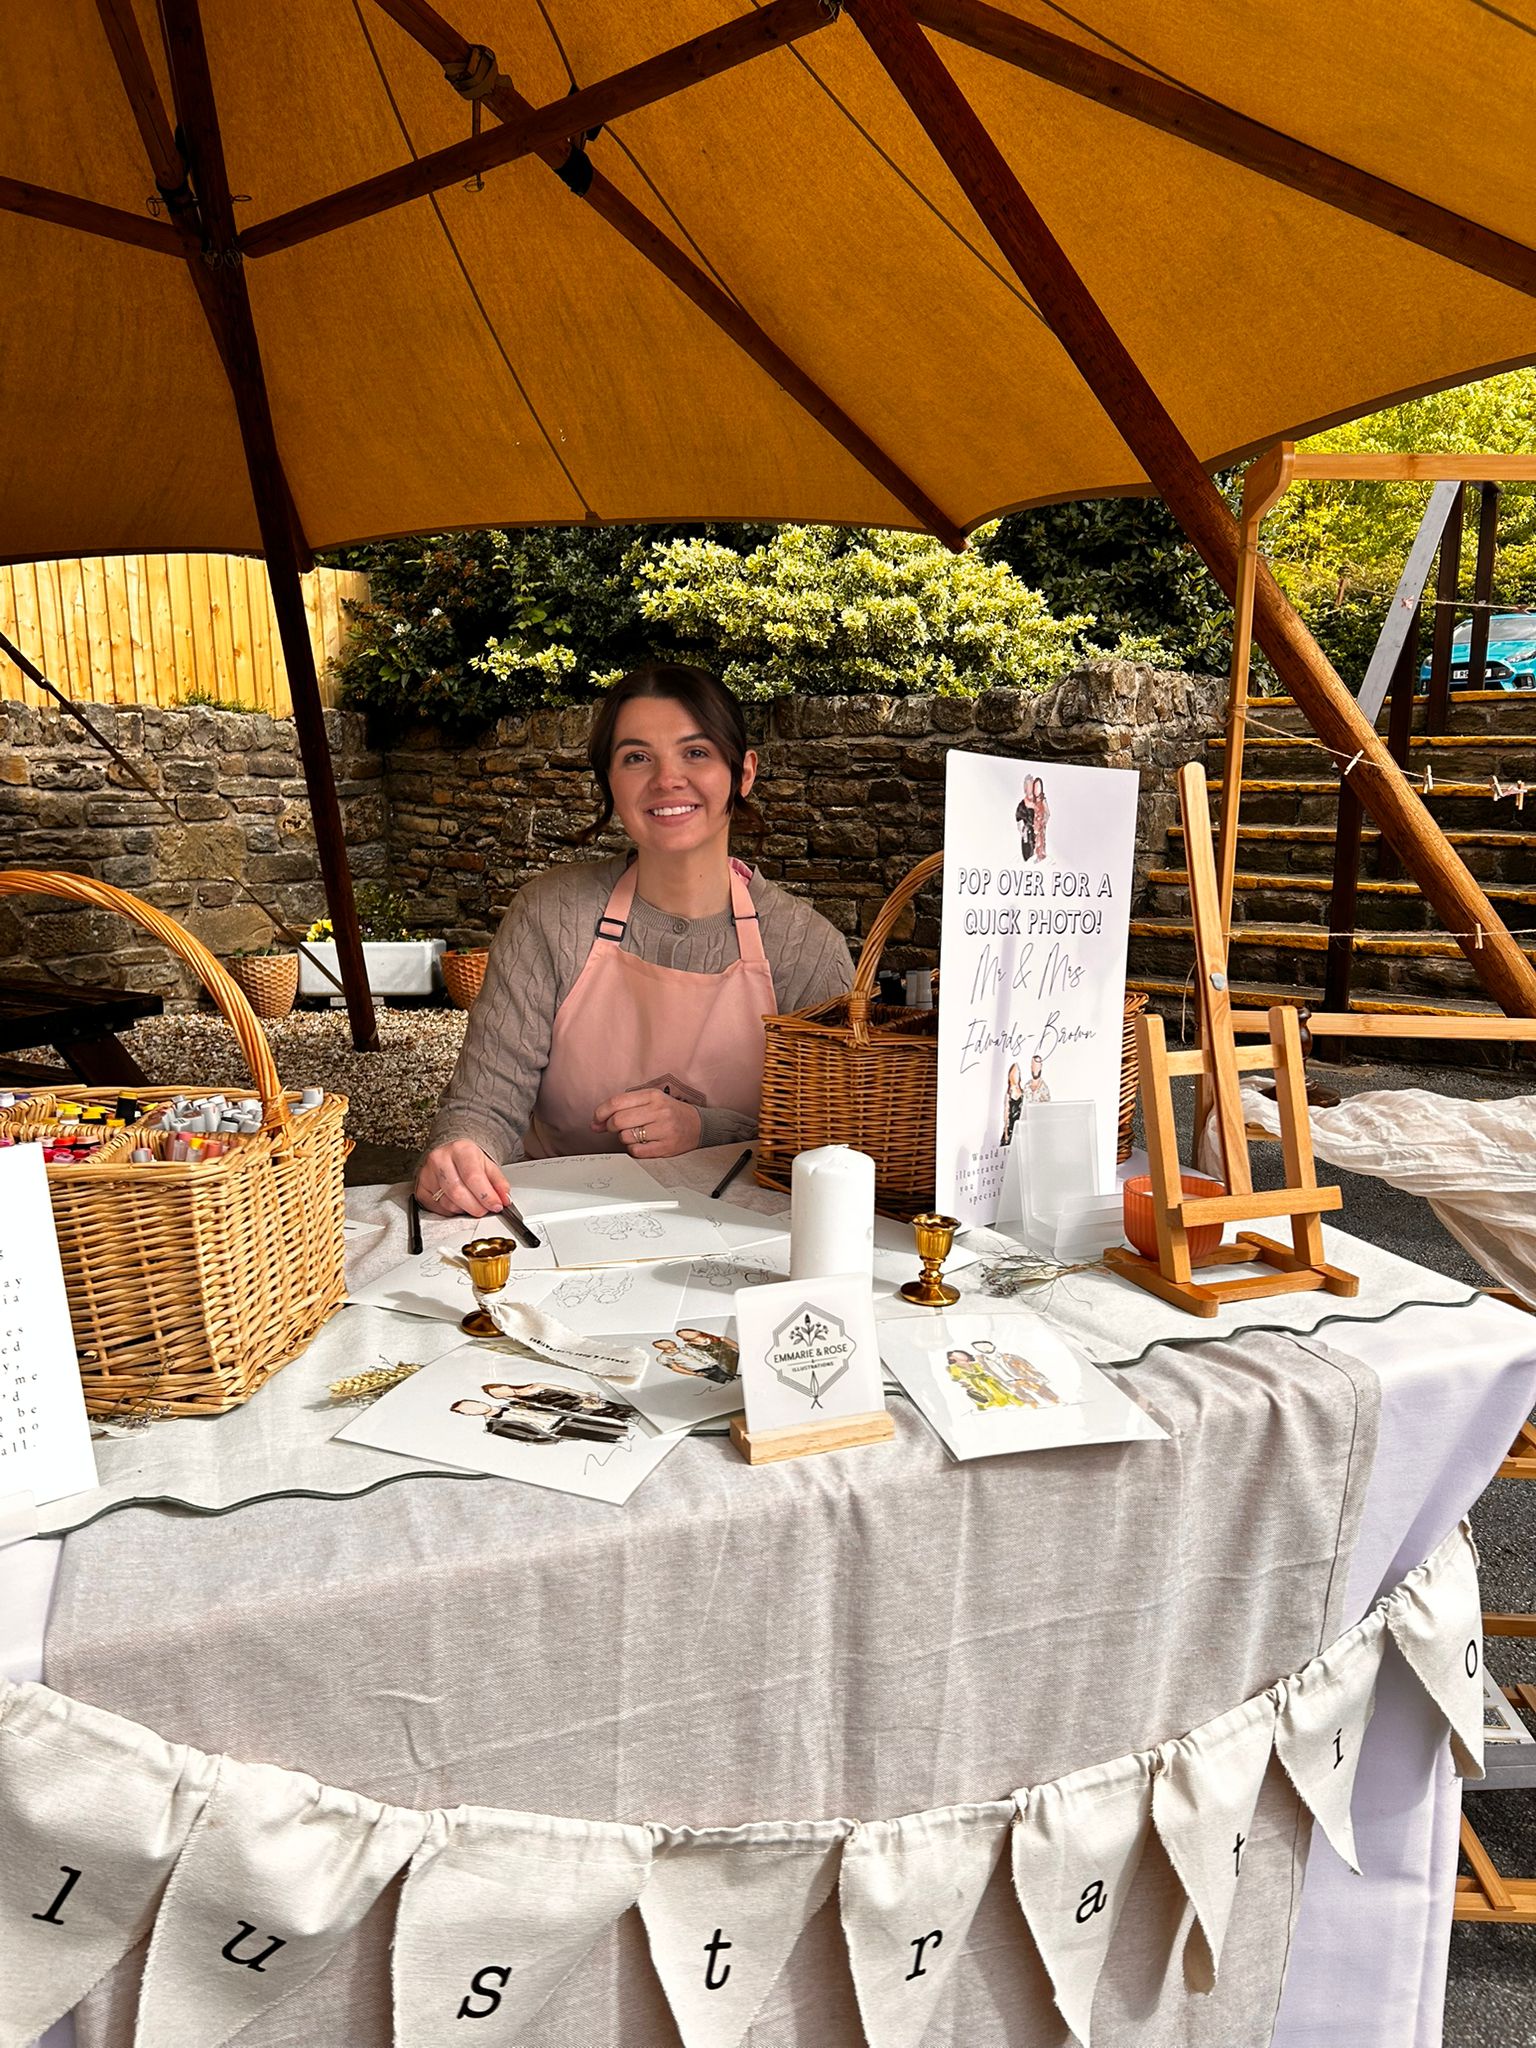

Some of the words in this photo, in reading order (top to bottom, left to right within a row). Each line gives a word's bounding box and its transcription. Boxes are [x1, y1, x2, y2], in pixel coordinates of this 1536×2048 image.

[958, 867, 992, 895] POP
[997, 869, 1045, 897] OVER
[1052, 872, 1090, 897] FOR
[1097, 873, 1112, 898] A
[964, 908, 1021, 935] QUICK
[1028, 908, 1102, 935] PHOTO!
[970, 944, 1007, 1005] Mr
[1012, 942, 1034, 989] &
[1038, 942, 1086, 1000] Mrs
[774, 1349, 814, 1364] EMMARIE
[815, 1347, 822, 1357] &
[823, 1343, 848, 1355] ROSE
[791, 1361, 834, 1373] ILLUSTRATIONS
